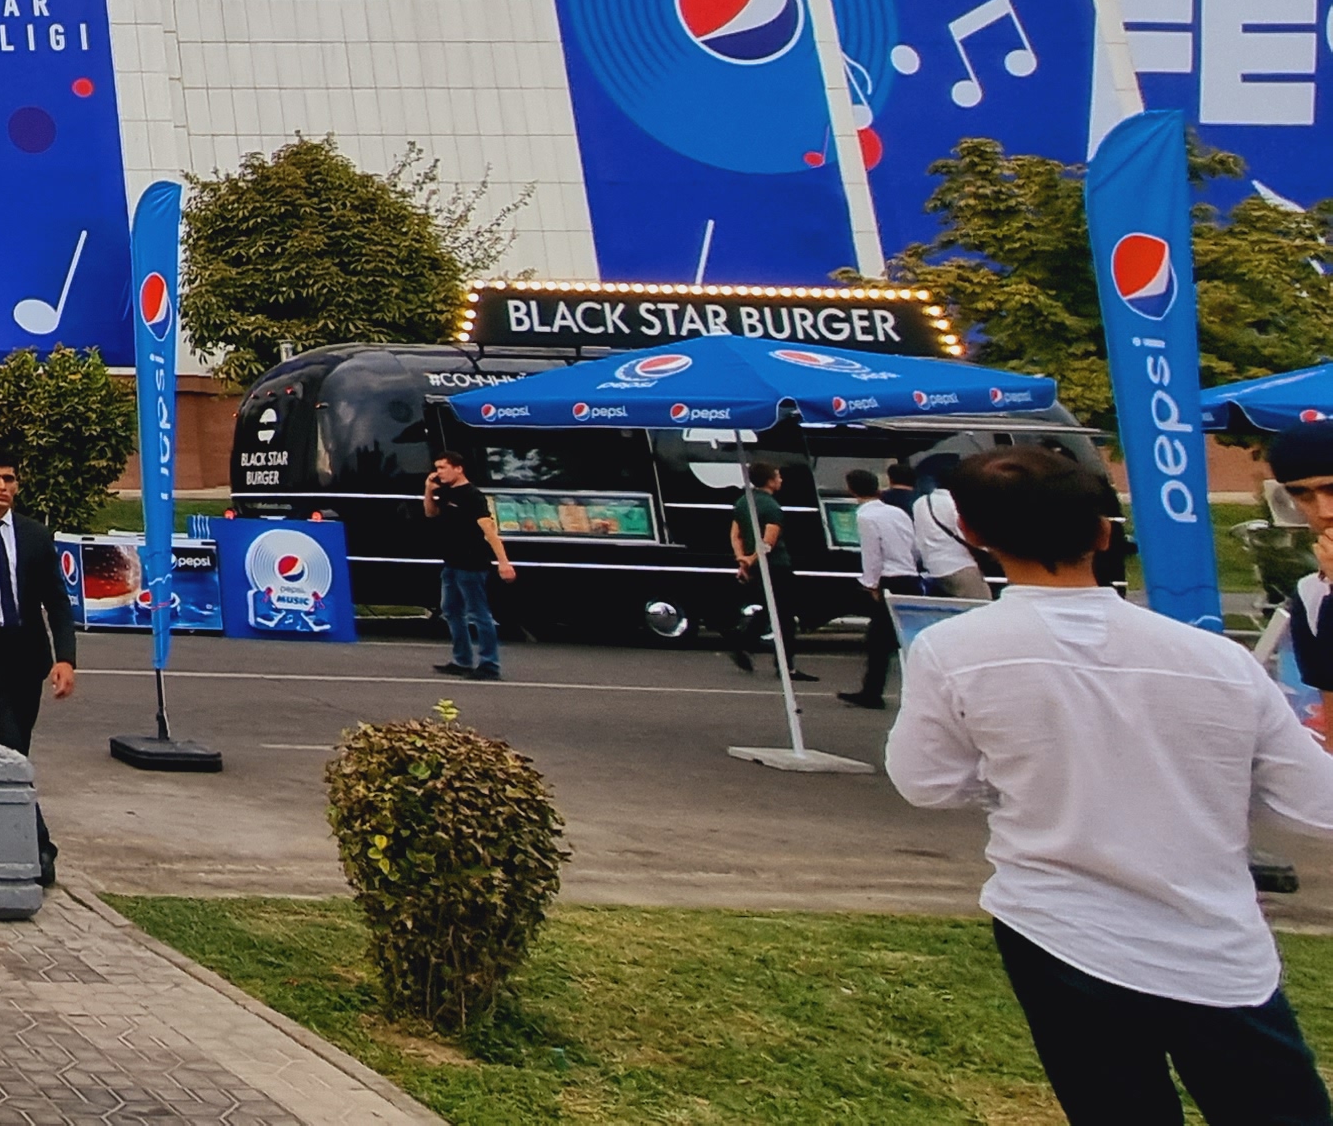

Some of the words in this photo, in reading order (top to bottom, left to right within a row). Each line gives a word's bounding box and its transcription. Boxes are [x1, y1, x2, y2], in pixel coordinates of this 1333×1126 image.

[507, 300, 631, 335] BLACK
[639, 303, 733, 336] STAR
[741, 307, 901, 343] BURGER
[497, 405, 531, 419] pepsi
[591, 405, 628, 419] pepsi
[690, 408, 731, 421] pepsi
[1132, 337, 1198, 523] pepsi
[240, 453, 266, 467] BLACK
[268, 451, 289, 466] STAR
[246, 470, 280, 485] BURGER
[178, 556, 211, 568] pepsi
